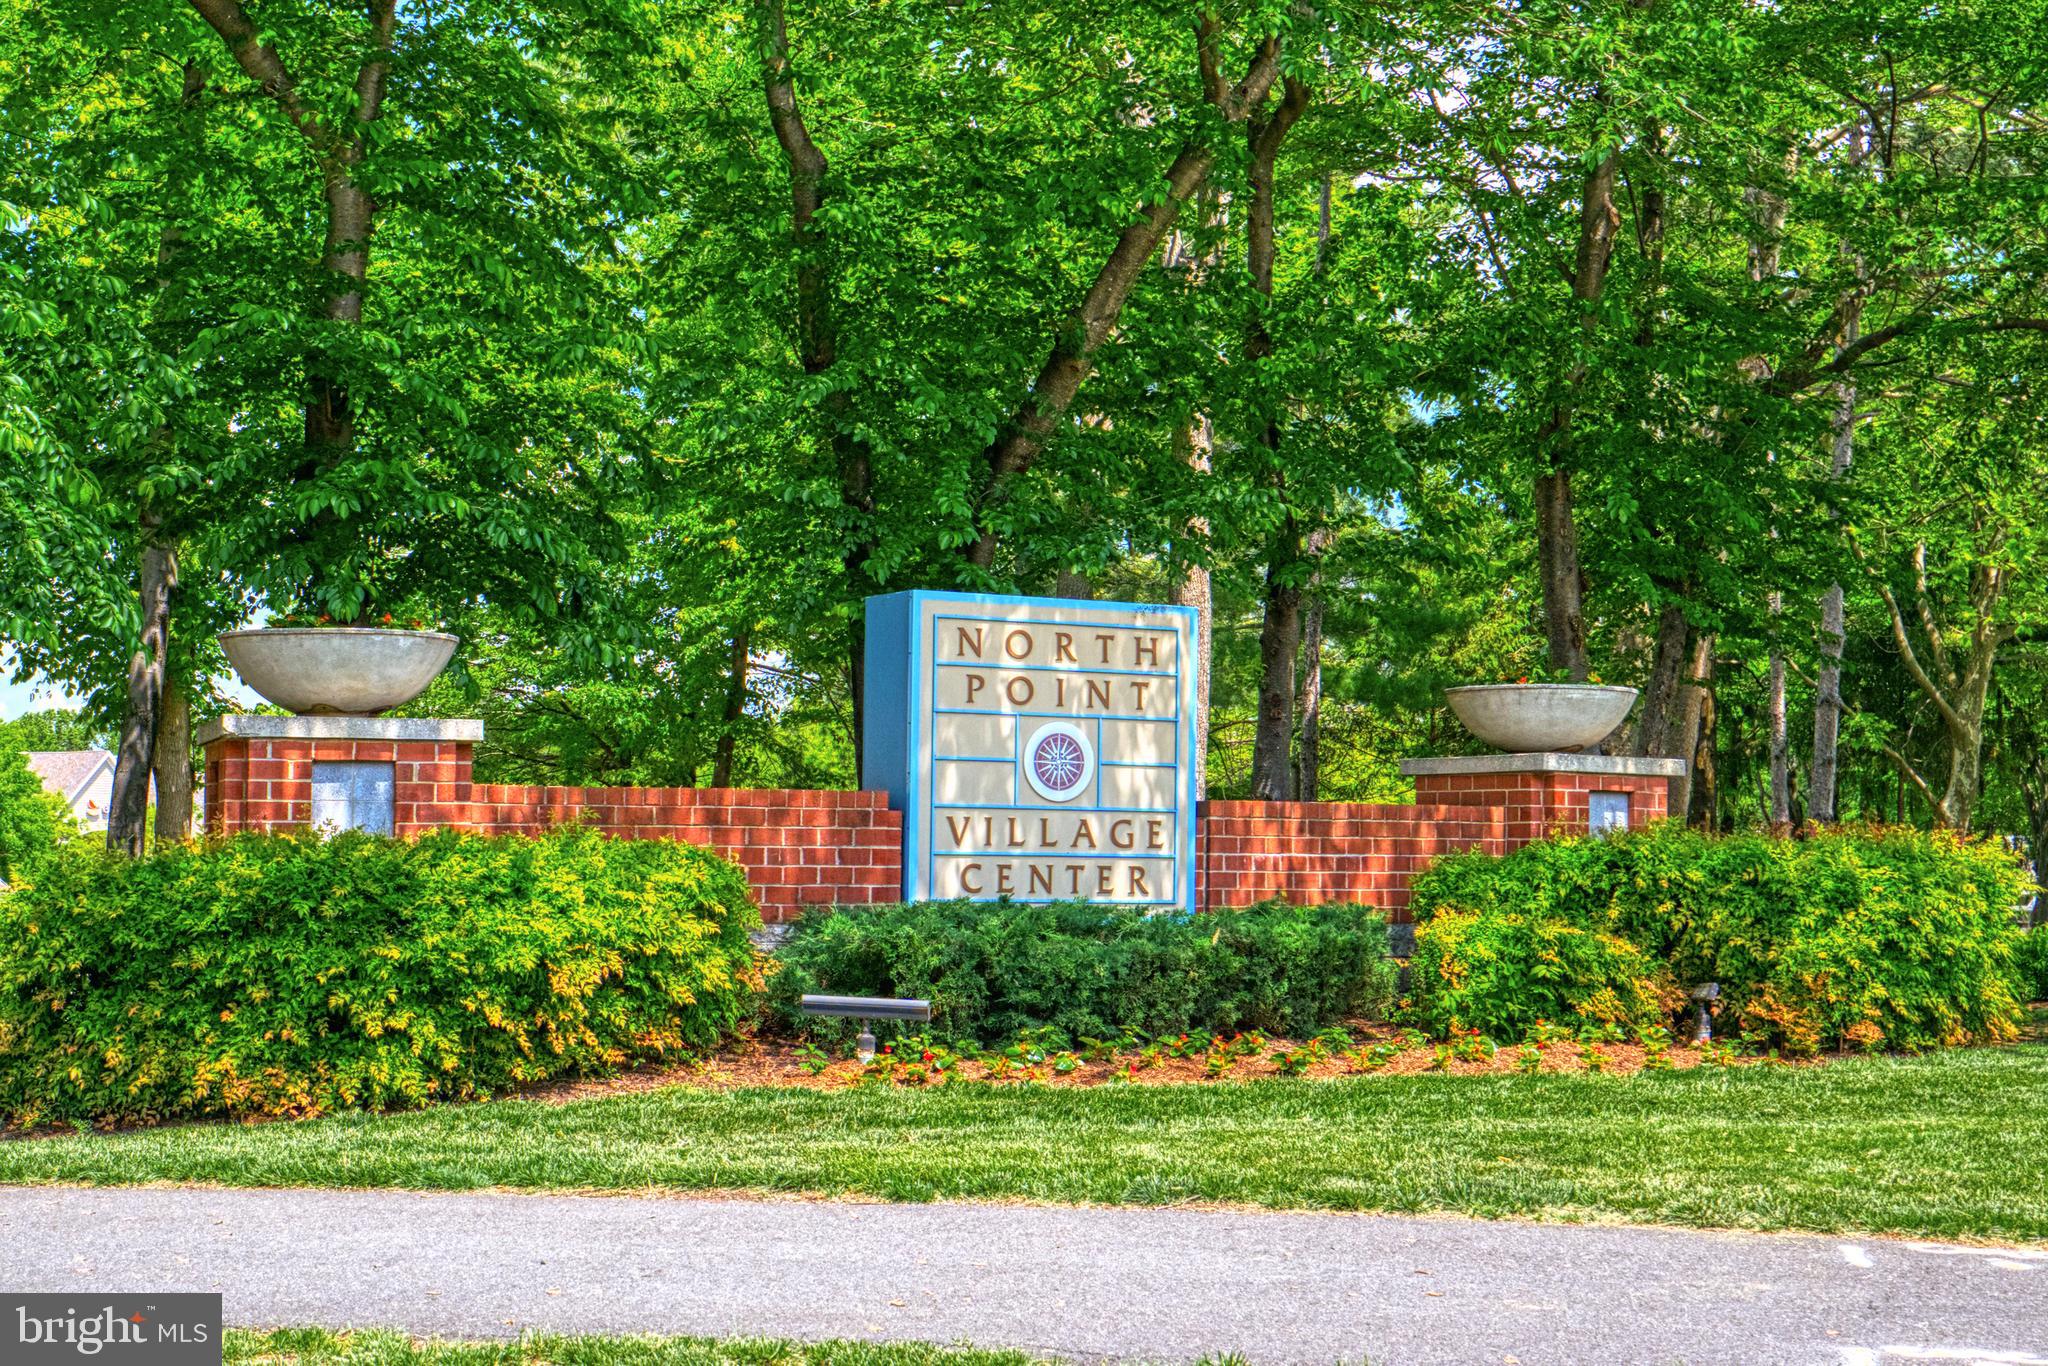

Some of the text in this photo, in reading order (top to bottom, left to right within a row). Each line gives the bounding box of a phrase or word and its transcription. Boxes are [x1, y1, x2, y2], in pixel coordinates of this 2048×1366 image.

[957, 627, 1158, 667] NORTH
[966, 674, 1150, 711] POINT
[946, 815, 1164, 850] VILLAGE
[960, 863, 1149, 896] CENTER
